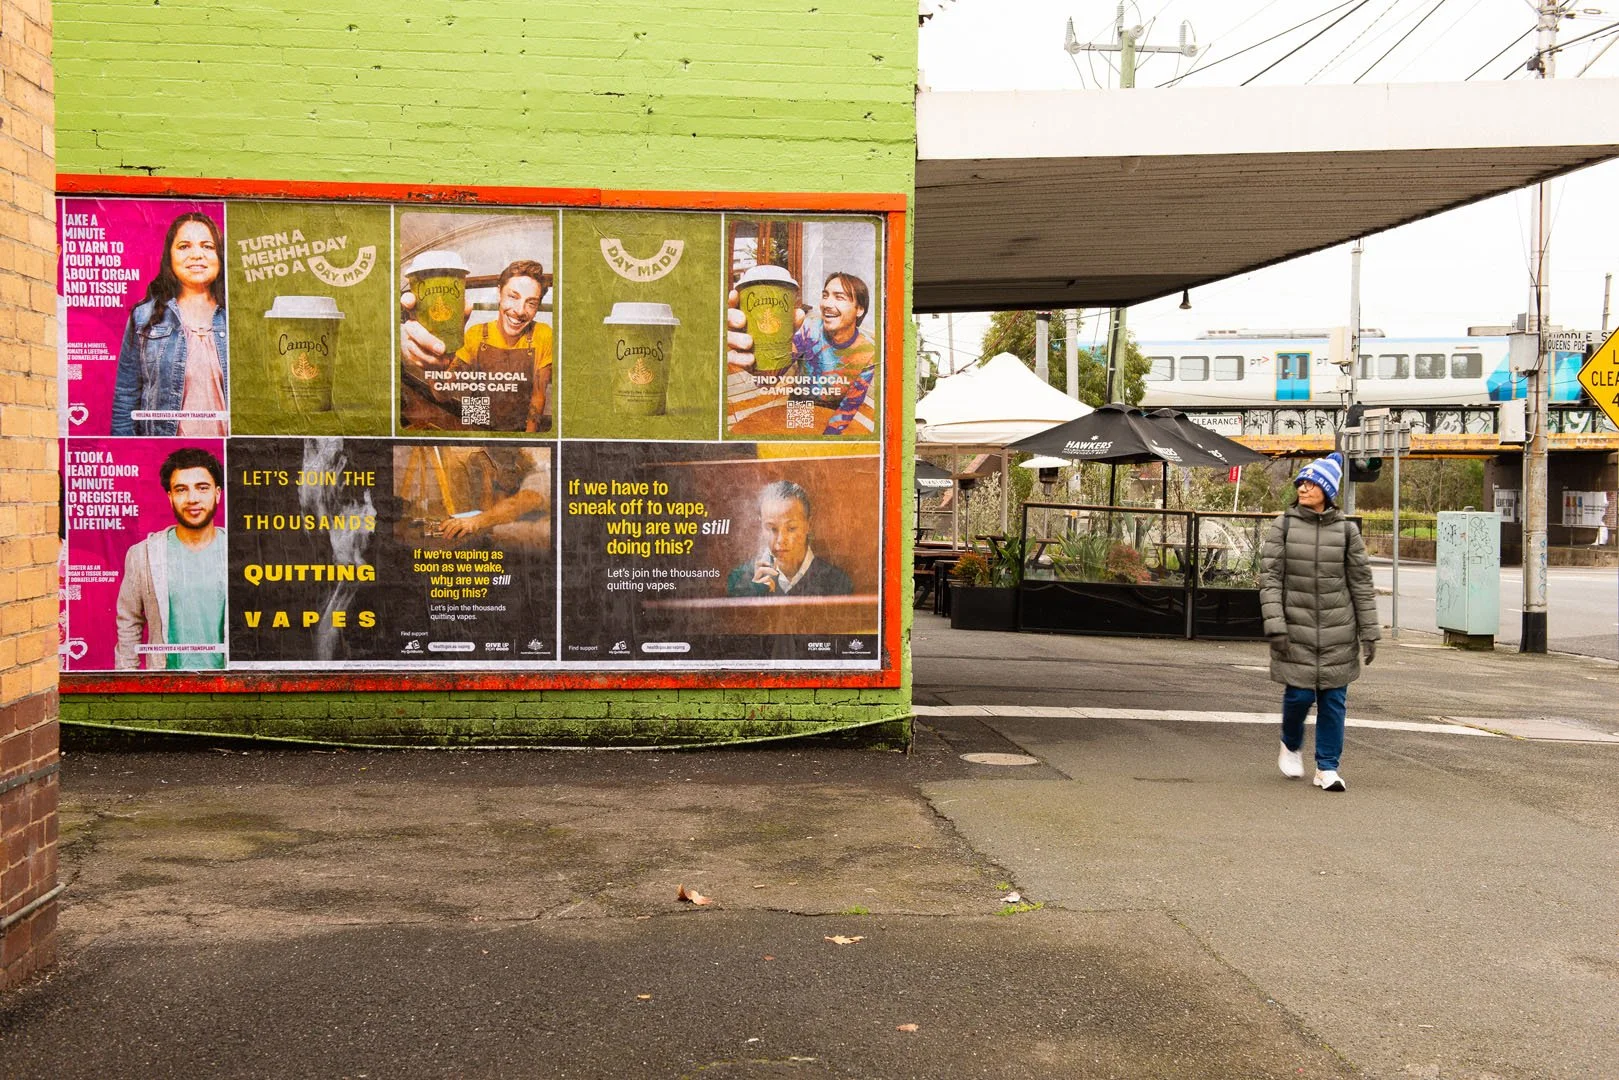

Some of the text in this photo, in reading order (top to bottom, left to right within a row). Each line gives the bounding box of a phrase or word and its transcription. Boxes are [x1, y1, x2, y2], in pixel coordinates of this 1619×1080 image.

[90, 213, 98, 226] A
[66, 227, 105, 240] MINUTE
[78, 241, 108, 253] YARN
[110, 241, 124, 254] TO
[237, 229, 306, 253] TURN A
[241, 235, 347, 268] MEHHH DAY
[94, 255, 122, 267] MOB
[315, 252, 372, 282] DAY MADE
[607, 246, 677, 277] DAY MADE
[66, 267, 140, 280] ABOUT ORGAN
[244, 260, 306, 283] INTO A
[66, 281, 127, 294] AND TISSUE
[66, 295, 124, 308] DONATION.
[1547, 340, 1586, 351] QUEENS PDE
[424, 370, 528, 382] FIND YOUR LOCAL
[752, 375, 850, 385] FIND YOUR LOCAL
[433, 383, 518, 392] CAMPOS CAFE
[760, 387, 842, 396] CAMPOS CAFE
[1192, 417, 1238, 426] CLEARANCE
[1065, 440, 1113, 450] HAWKERS
[67, 451, 114, 463] T TOOK A
[100, 465, 139, 477] DONOR
[71, 478, 114, 490] MINUTE
[243, 470, 376, 487] LET'S JOIN THE
[568, 479, 669, 495] If we have to
[80, 491, 135, 503] REGISTER.
[67, 504, 139, 517] T'S GIVEN ME
[568, 499, 709, 518] sneak off to vape,
[73, 518, 125, 530] LIFETIME.
[243, 514, 376, 531] THOUSANDS
[607, 519, 730, 538] why are we still
[607, 539, 694, 557] doing this?
[413, 548, 504, 562] If we're vaping as
[413, 562, 505, 574] soon as we wake,
[607, 568, 720, 580] Let's join the thousands
[244, 564, 376, 586] QUITTING
[430, 574, 512, 587] why are we still
[607, 580, 677, 592] quitting vapes.
[430, 588, 488, 600] doing this?
[447, 604, 459, 612] join
[244, 610, 376, 628] VAPES
[430, 613, 455, 621] quitting
